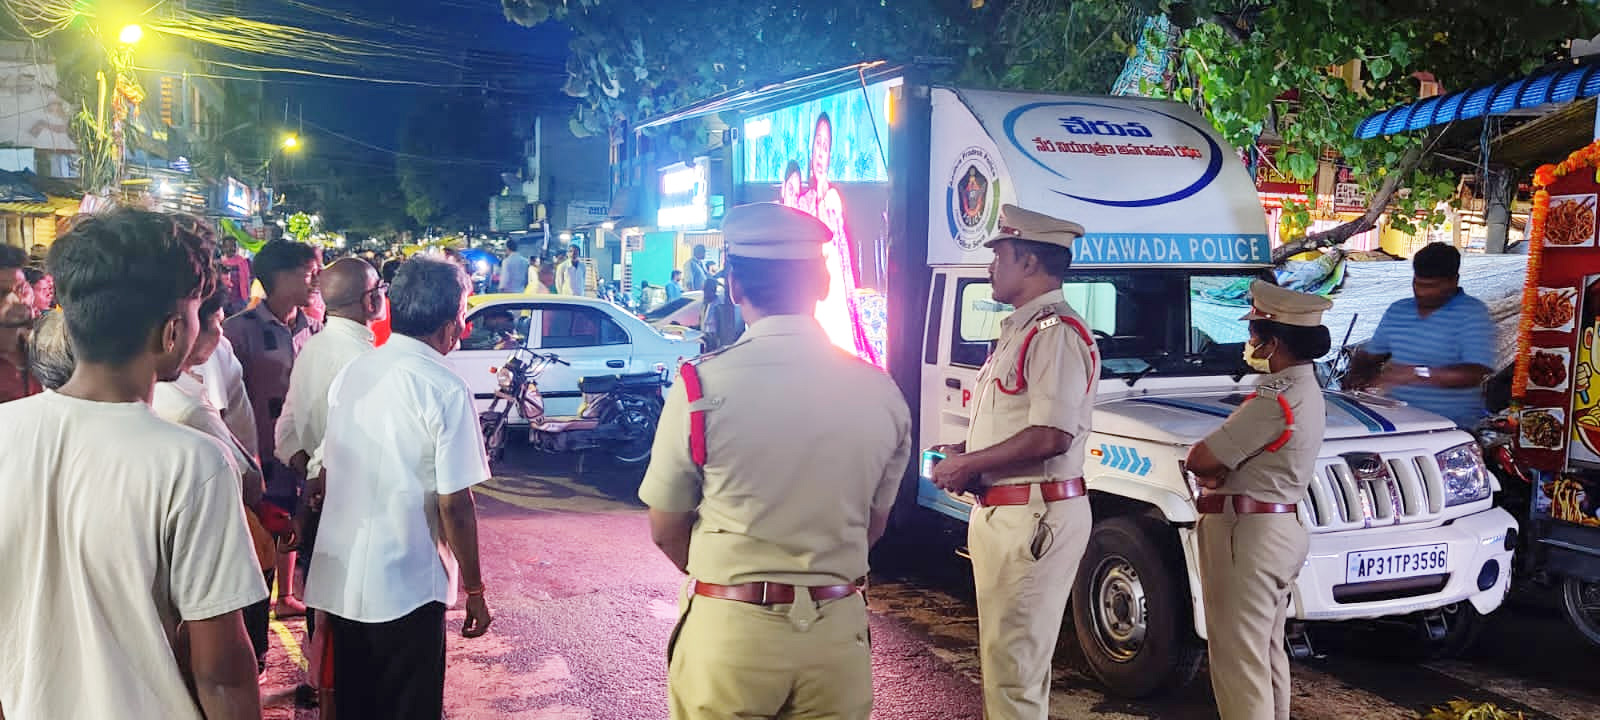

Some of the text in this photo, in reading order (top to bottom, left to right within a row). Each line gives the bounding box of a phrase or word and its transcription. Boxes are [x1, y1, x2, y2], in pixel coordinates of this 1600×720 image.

[1058, 116, 1152, 138] చేరువ
[1189, 238, 1260, 261] POLICE
[1358, 550, 1445, 577] AP31TP3596
